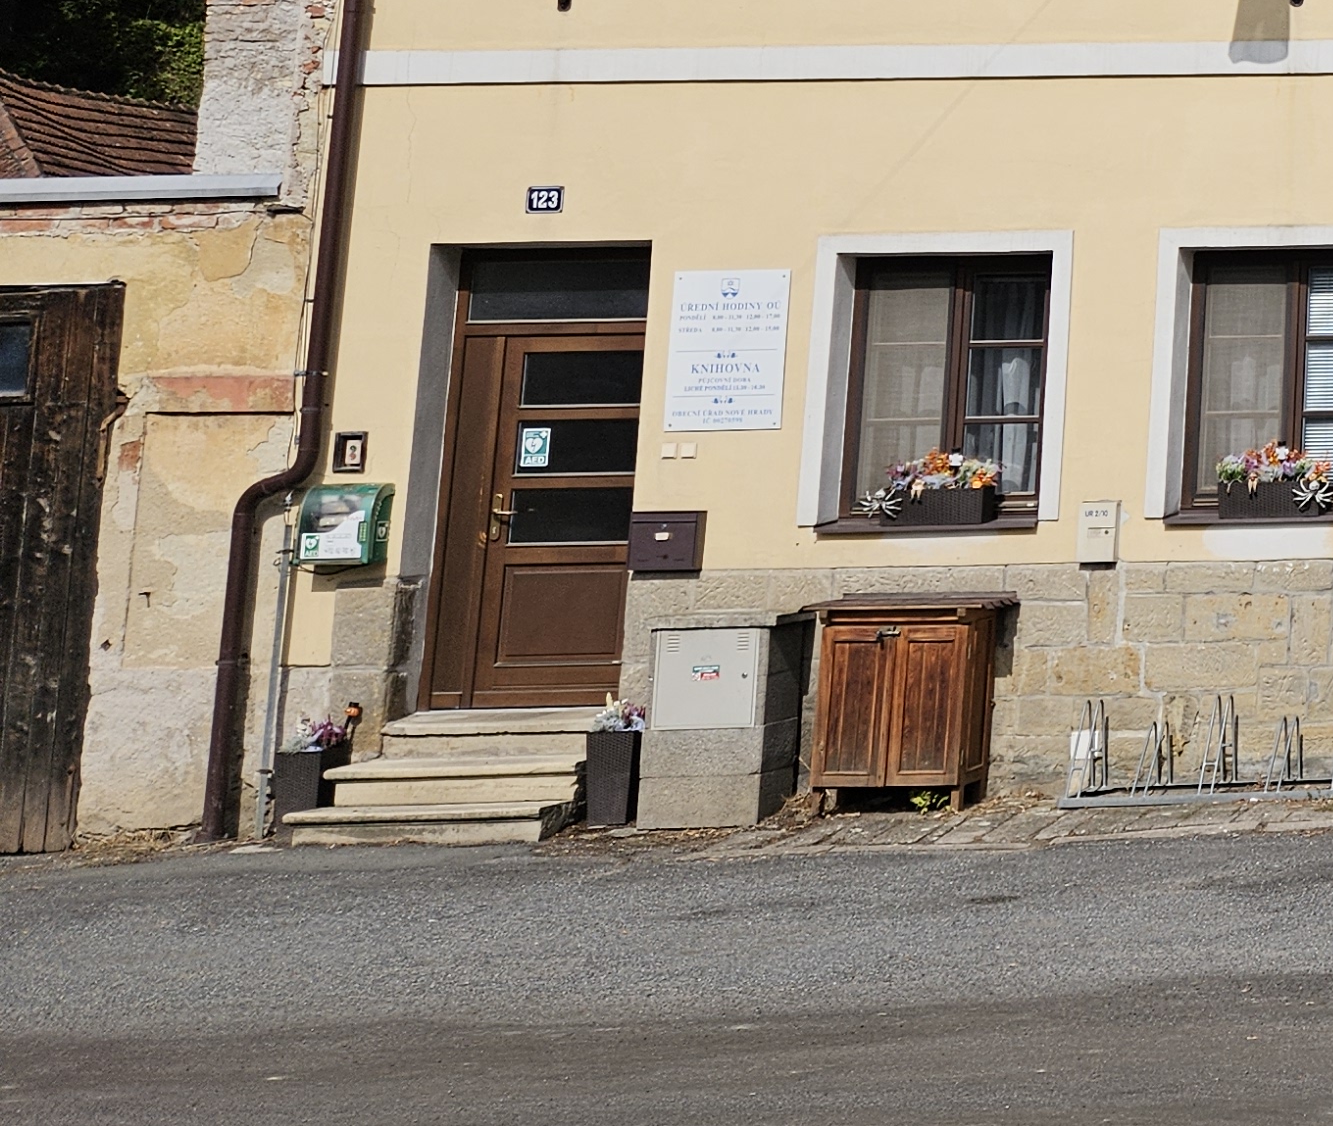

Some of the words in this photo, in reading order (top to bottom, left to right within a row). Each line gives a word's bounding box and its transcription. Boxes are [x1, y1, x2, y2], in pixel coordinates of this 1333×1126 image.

[530, 190, 559, 209] 123
[680, 301, 719, 312] ÚŘEDNÍ
[722, 301, 763, 311] HODINY
[691, 363, 760, 374] KNIHOVNA
[525, 456, 545, 465] AED
